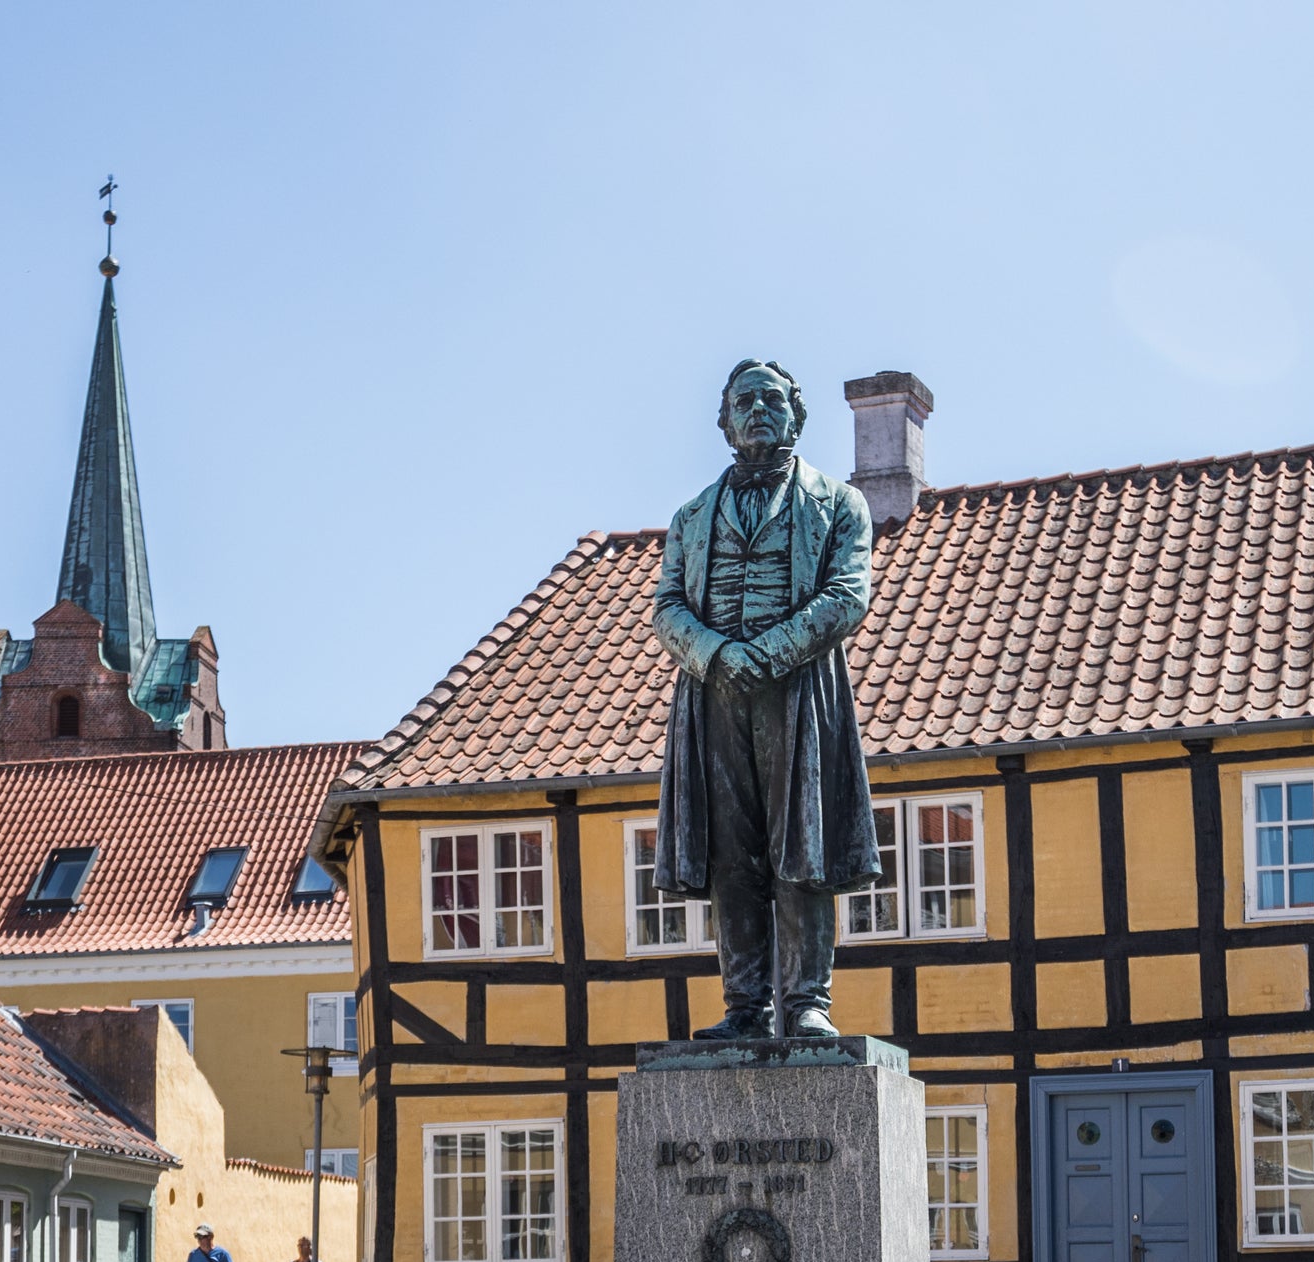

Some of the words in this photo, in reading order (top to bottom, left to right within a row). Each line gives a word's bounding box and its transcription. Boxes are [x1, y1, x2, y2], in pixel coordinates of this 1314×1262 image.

[1117, 1059, 1122, 1072] 1
[714, 1138, 834, 1165] ØRSTED
[685, 1176, 728, 1194] 1777
[763, 1175, 806, 1193] 1851
